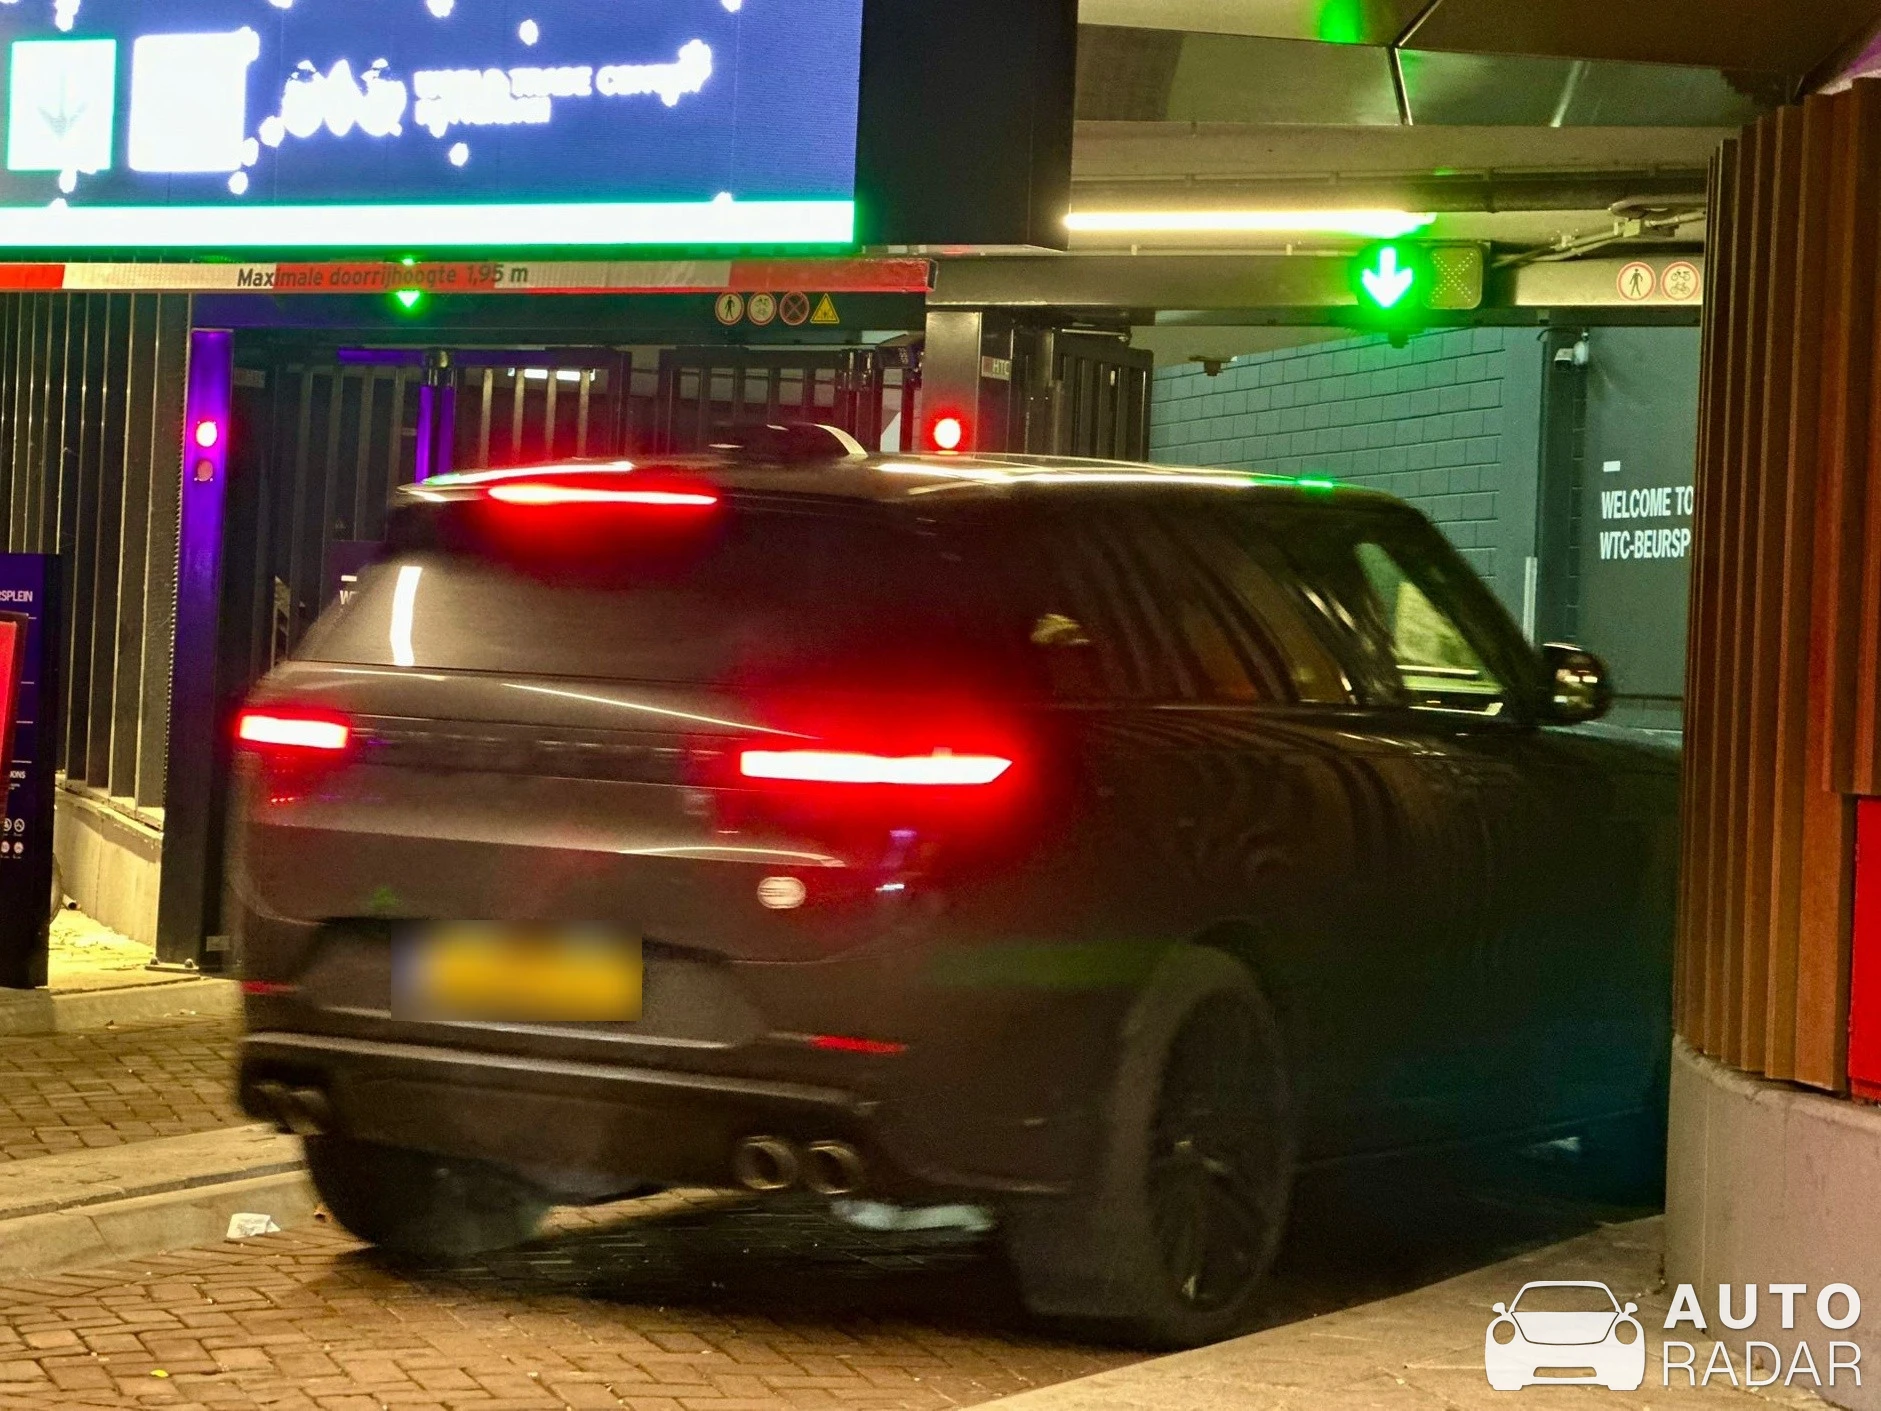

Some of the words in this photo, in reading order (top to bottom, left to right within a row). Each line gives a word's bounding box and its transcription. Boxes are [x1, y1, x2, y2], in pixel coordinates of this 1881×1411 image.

[237, 267, 323, 287] Maximale
[329, 264, 457, 289] doorrijhoogte
[467, 263, 505, 285] 1,95
[510, 265, 529, 283] m
[1601, 487, 1671, 519] WELCOME
[1675, 486, 1694, 516] TO
[1600, 527, 1692, 560] WTC-BEURSP
